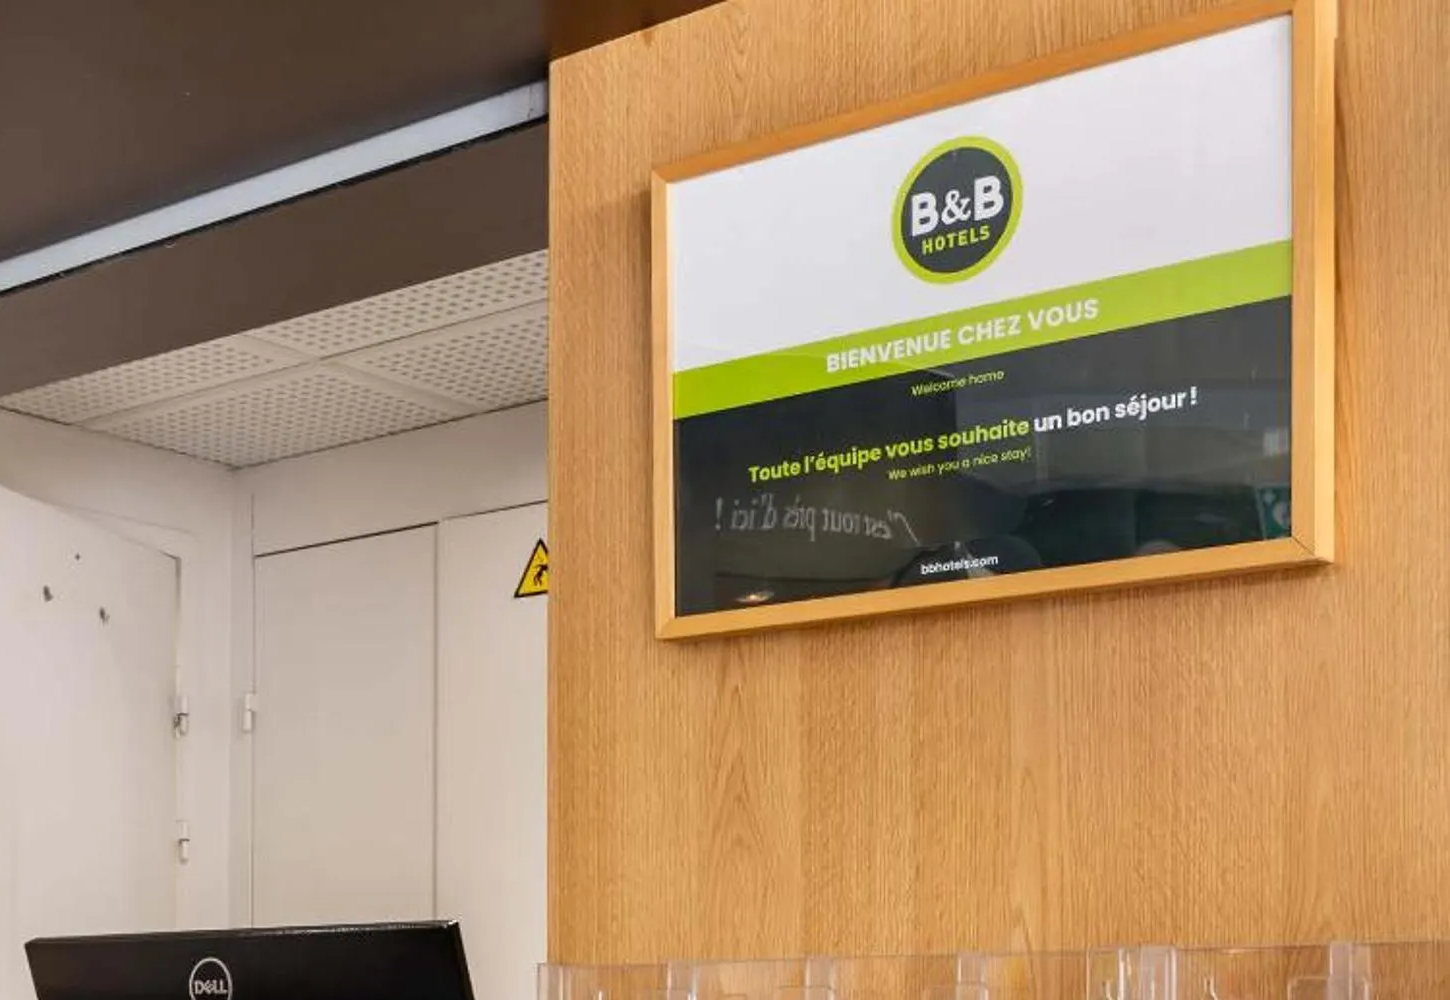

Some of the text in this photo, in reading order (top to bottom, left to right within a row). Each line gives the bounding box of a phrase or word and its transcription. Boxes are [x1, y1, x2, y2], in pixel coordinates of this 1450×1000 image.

[911, 175, 1004, 237] B&B
[921, 225, 990, 255] HOTELS
[826, 299, 1099, 373] BIENVENUE CHEZ VOUS
[911, 369, 1005, 397] Welcome home
[749, 461, 801, 483] Toute
[804, 447, 881, 473] l'équipe
[885, 437, 934, 458] vous
[938, 418, 1029, 449] souhaite
[1034, 416, 1062, 432] un
[1066, 404, 1111, 428] bon
[1115, 390, 1187, 421] séjour
[888, 469, 907, 481] We
[909, 463, 935, 477] wish
[937, 460, 960, 475] you
[973, 453, 999, 466] nice
[920, 555, 999, 575] bbhotels.com
[194, 979, 228, 995] DELL
